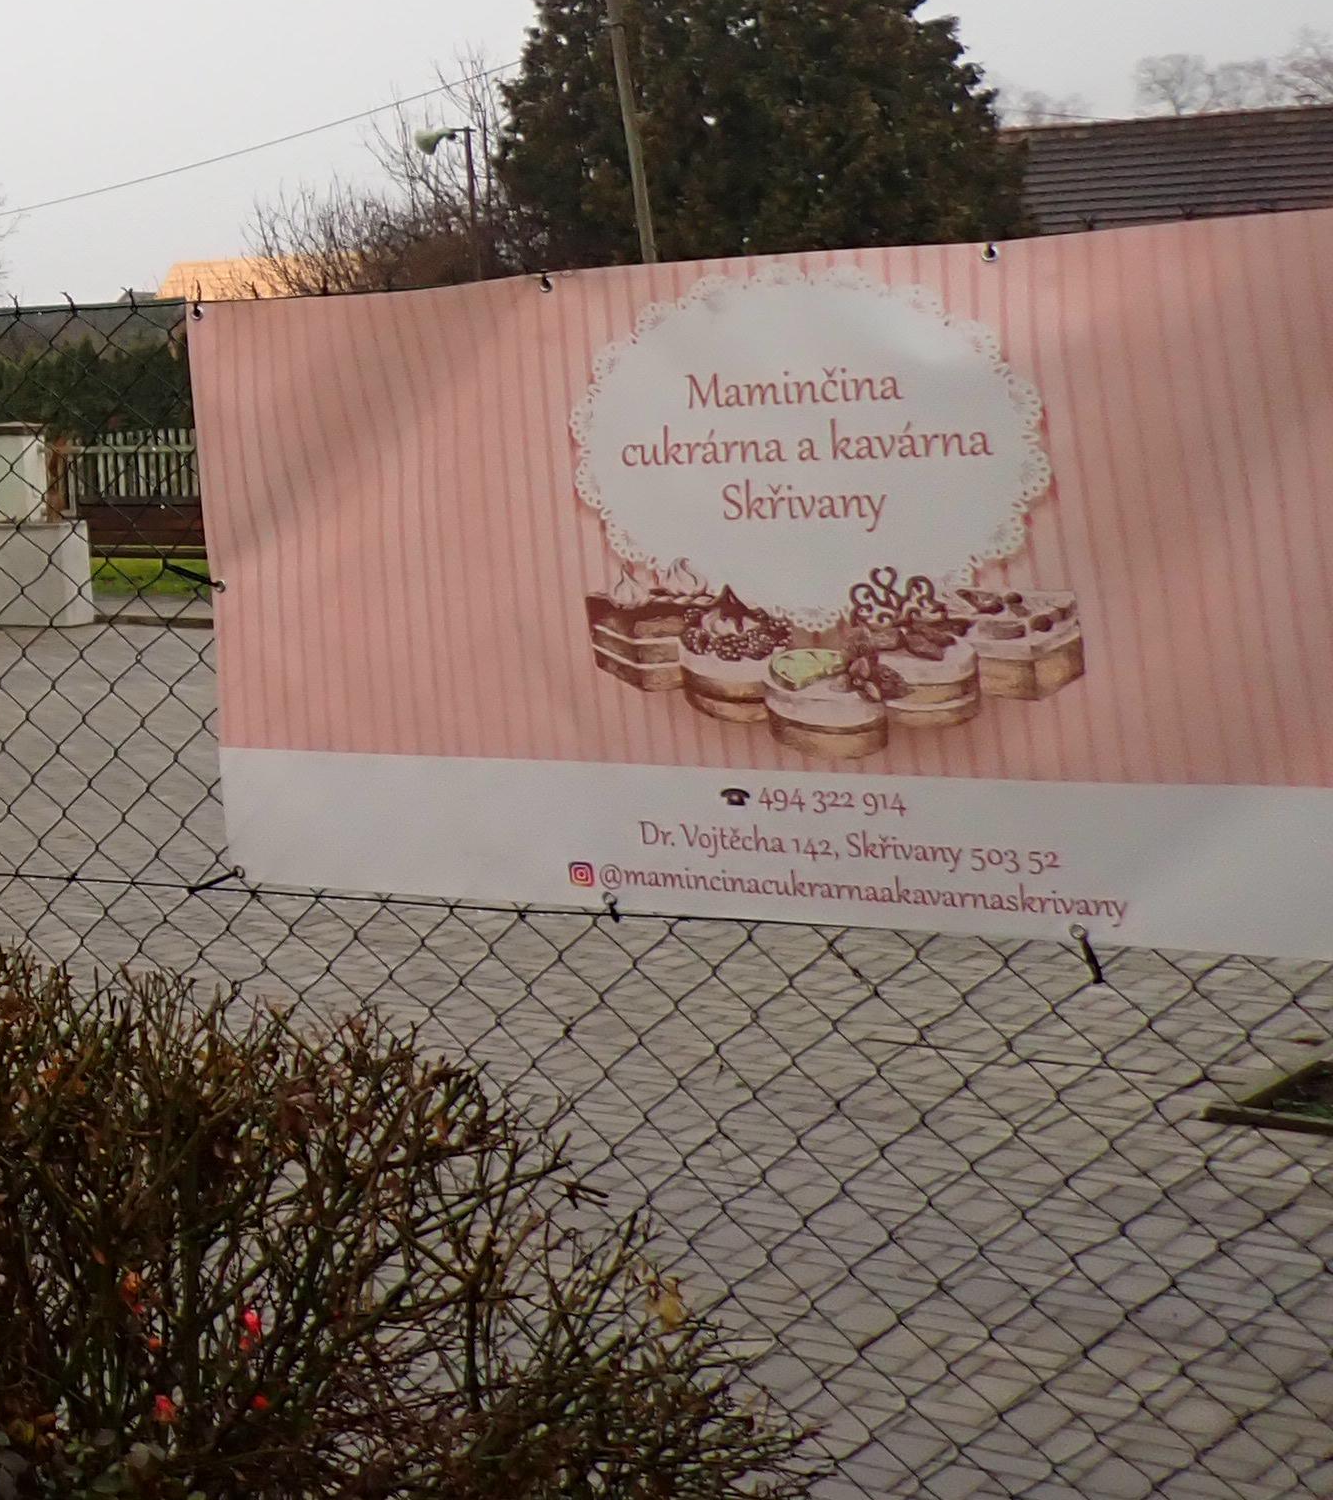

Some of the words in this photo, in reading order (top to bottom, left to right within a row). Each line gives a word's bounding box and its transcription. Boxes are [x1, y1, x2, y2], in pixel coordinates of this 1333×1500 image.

[685, 367, 903, 410] Maminčina
[621, 424, 782, 467] cukrárna
[797, 437, 818, 461] a
[830, 418, 994, 461] kavárna
[721, 479, 887, 532] Skřivany
[758, 787, 806, 812] 494
[812, 789, 855, 814] 322
[862, 792, 907, 817] 914
[638, 820, 675, 847] Dr.
[679, 823, 786, 858] Vojtěcha
[790, 837, 839, 861] 142,
[846, 829, 962, 873] Skřivany
[970, 848, 1020, 874] 503
[1028, 850, 1061, 875] 52
[599, 863, 1128, 927] @mamincinacukrarnaakavarnaskrivany
